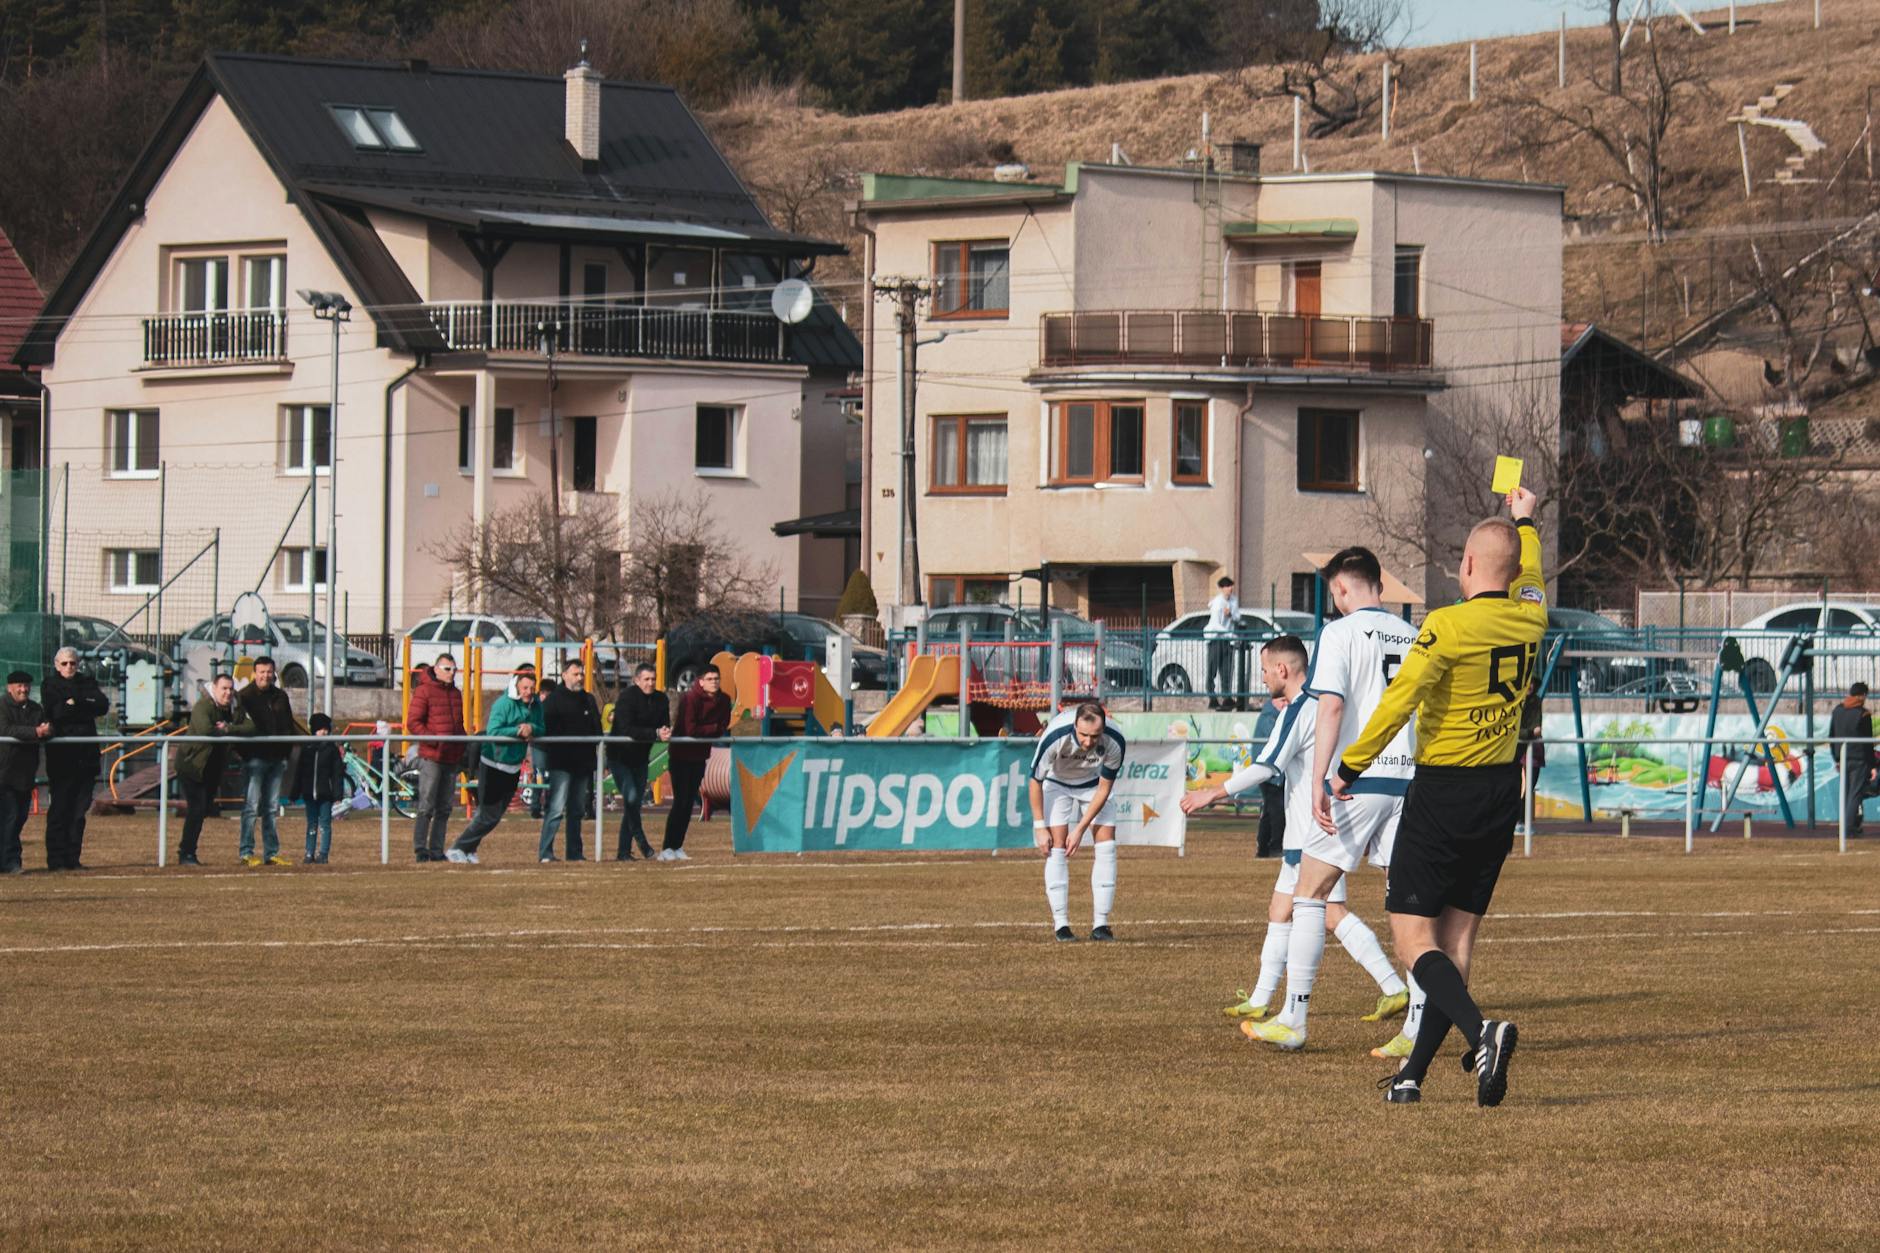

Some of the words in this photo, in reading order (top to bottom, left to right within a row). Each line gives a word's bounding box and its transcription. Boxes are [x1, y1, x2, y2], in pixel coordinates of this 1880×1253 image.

[1376, 630, 1416, 645] Tipspor
[1127, 761, 1169, 780] teraz
[802, 758, 1025, 845] Tipsport
